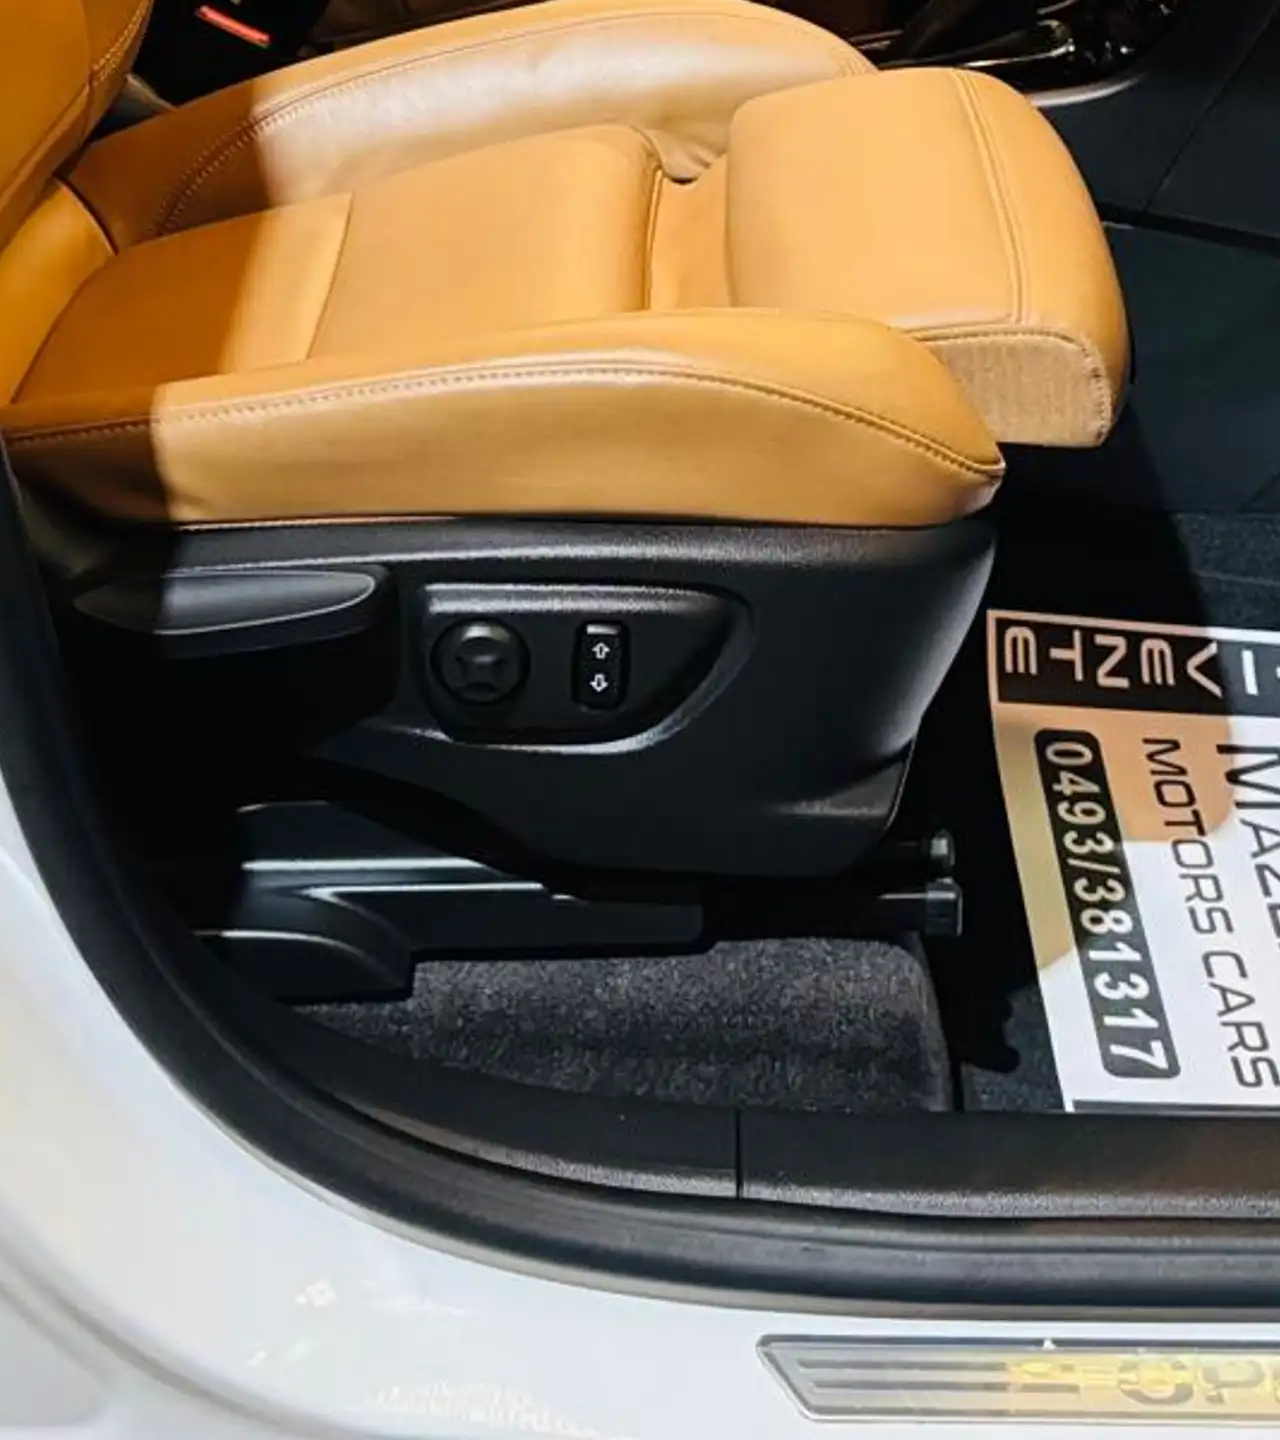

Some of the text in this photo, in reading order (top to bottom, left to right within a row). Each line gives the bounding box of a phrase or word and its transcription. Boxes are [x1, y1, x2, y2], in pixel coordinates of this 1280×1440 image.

[1004, 626, 1224, 698] VENTE
[1044, 740, 1170, 1073] 0493/381317
[1142, 737, 1280, 1089] MOTORS CARS
